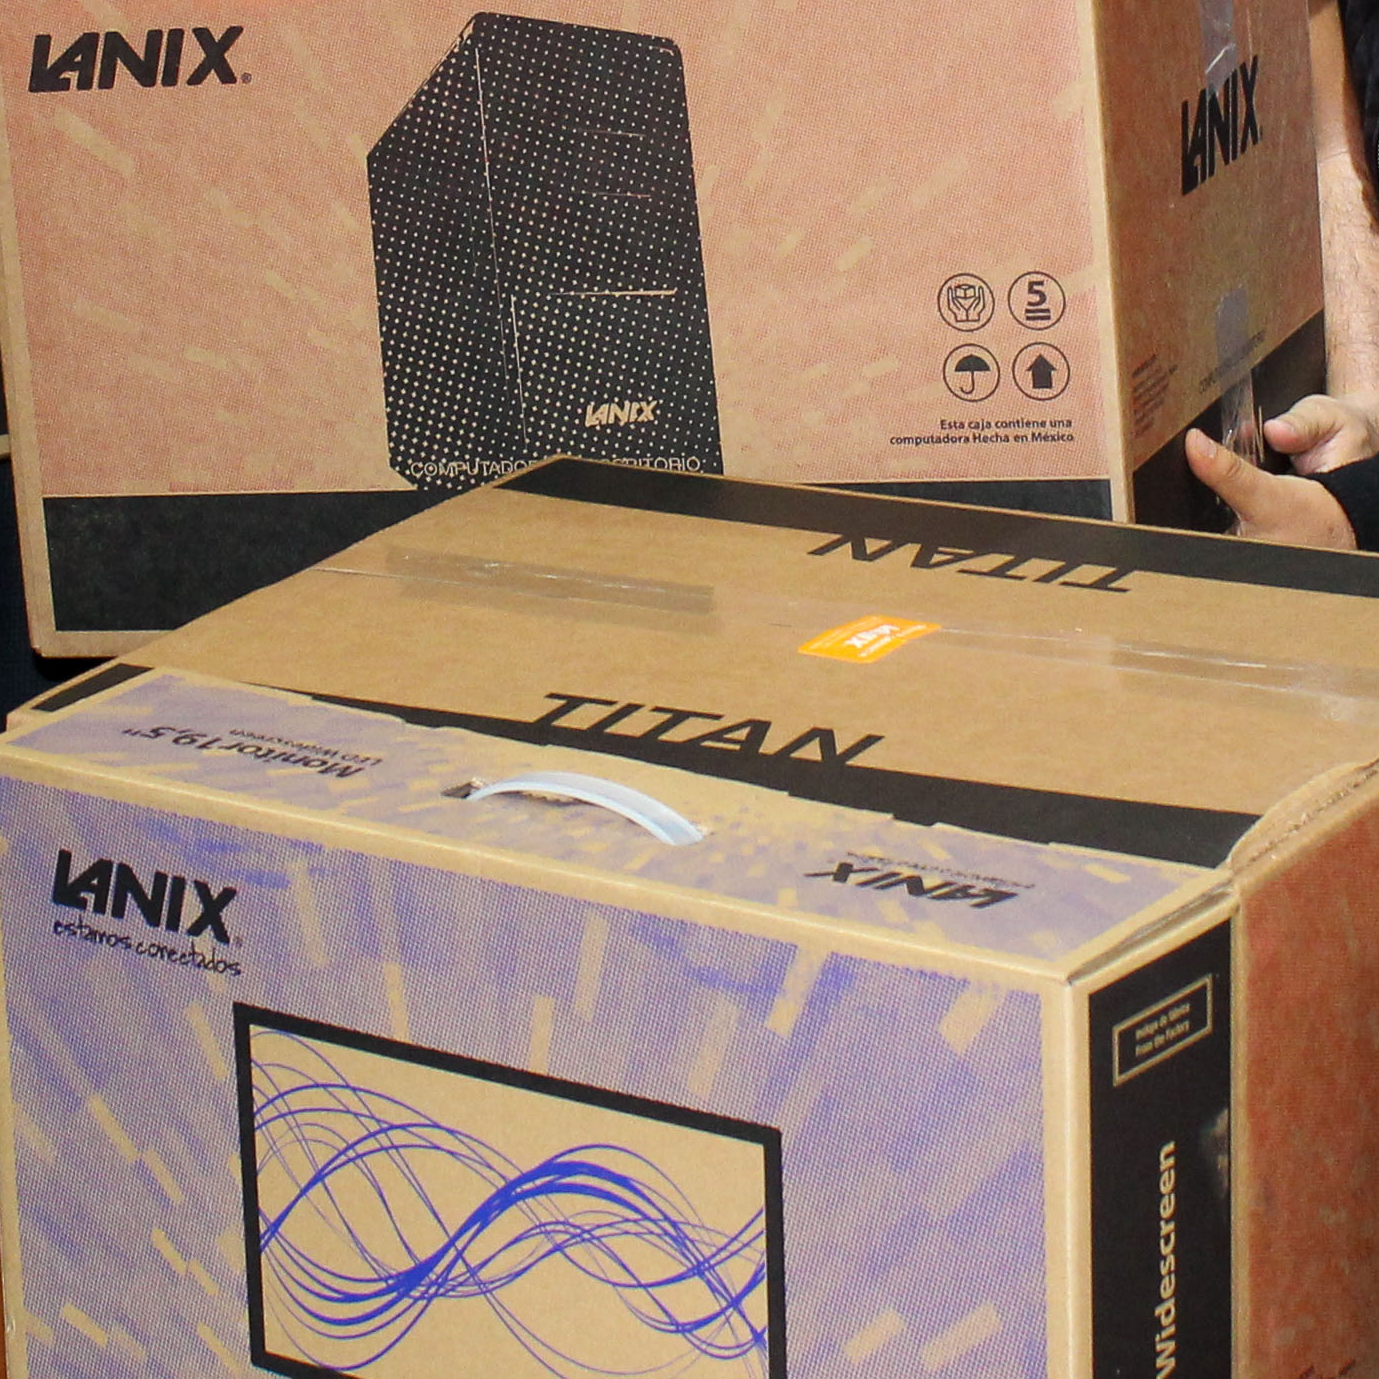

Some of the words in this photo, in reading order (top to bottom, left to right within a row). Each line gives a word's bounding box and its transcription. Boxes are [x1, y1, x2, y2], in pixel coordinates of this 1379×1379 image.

[28, 25, 245, 93] LANIX
[1181, 55, 1260, 196] LANIX
[585, 400, 657, 427] LANIX
[890, 433, 970, 447] computadora
[972, 432, 1010, 444] Hecha
[1013, 432, 1028, 443] en
[1031, 429, 1074, 444] México
[940, 419, 965, 431] Esta
[967, 418, 992, 432] caja
[994, 418, 1046, 429] contiene
[1049, 419, 1073, 428] una
[410, 458, 538, 478] COMPUTADO
[807, 532, 1139, 594] TITAN
[534, 692, 886, 768] TITAN
[53, 848, 237, 946] LANIX
[804, 862, 1019, 909] LANIX
[1155, 1140, 1176, 1379] Widescreen
